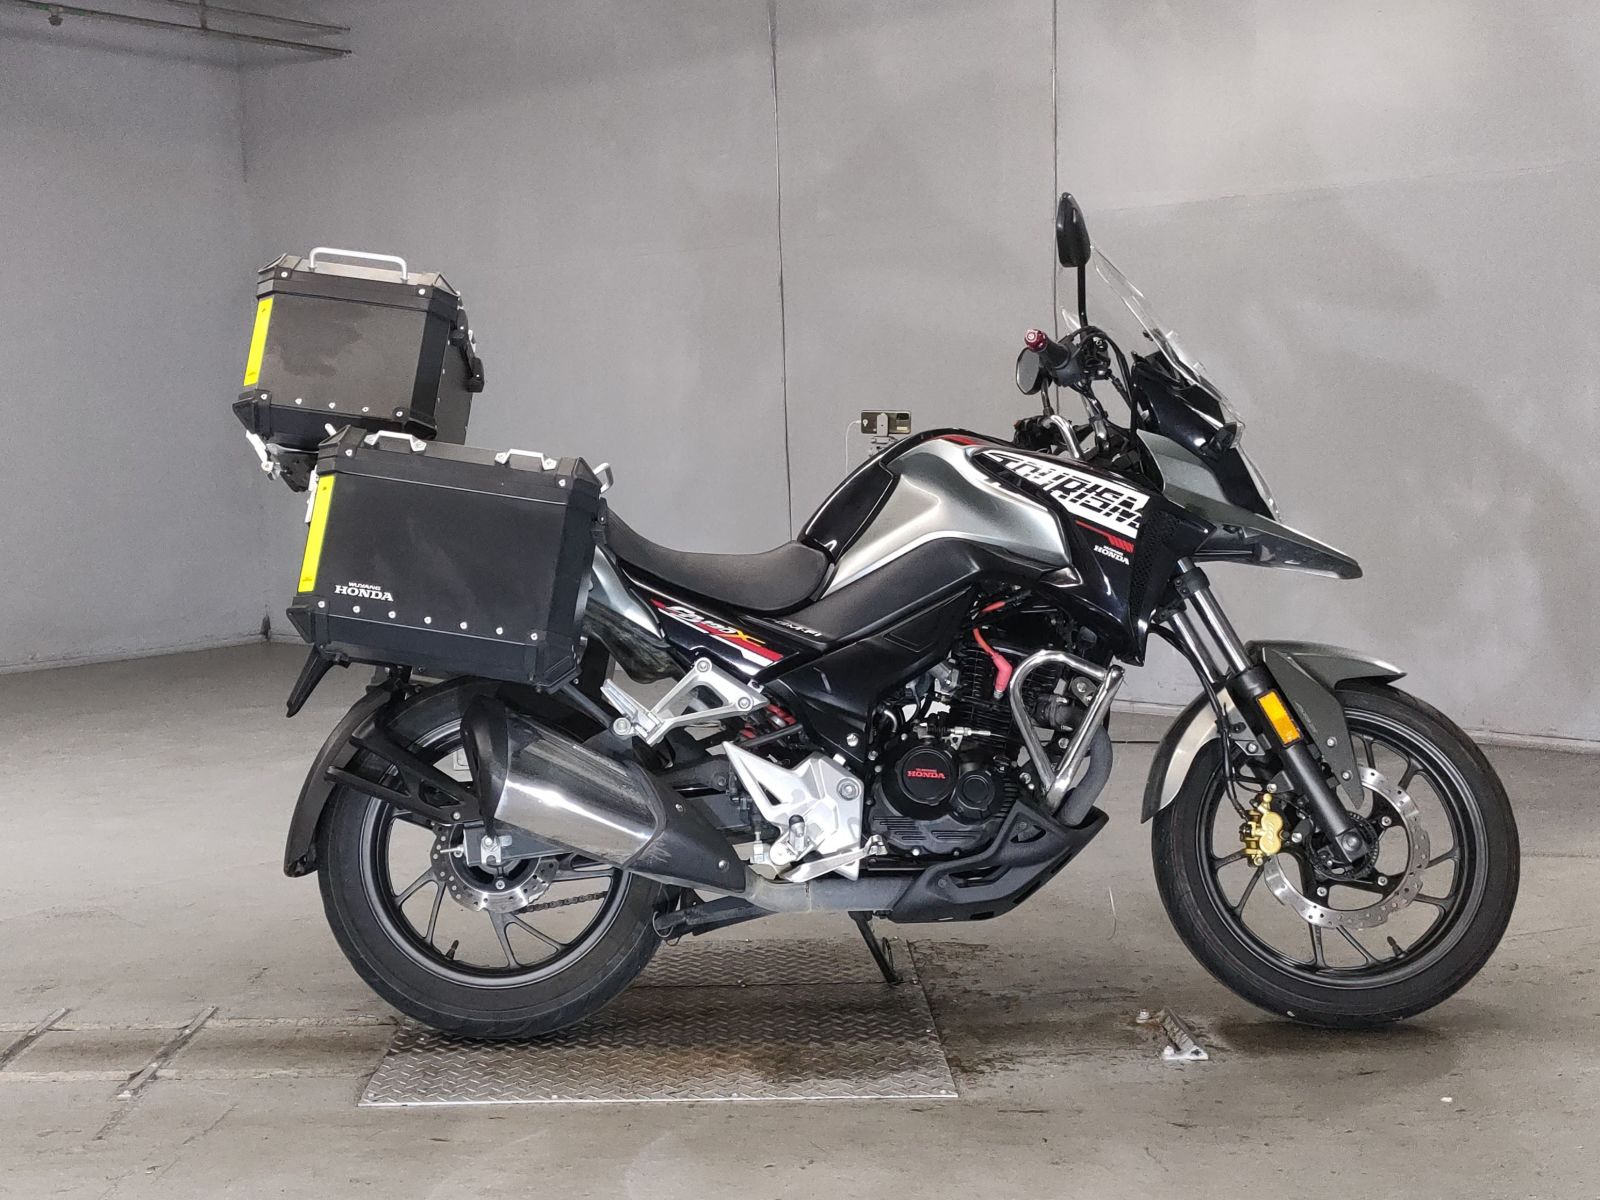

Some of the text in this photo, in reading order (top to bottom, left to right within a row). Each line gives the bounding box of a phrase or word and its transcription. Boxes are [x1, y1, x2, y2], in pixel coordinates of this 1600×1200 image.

[1094, 545, 1130, 565] HONDA
[348, 582, 381, 591] WUYANG
[334, 585, 394, 602] HONDA
[907, 770, 946, 780] HONDA
